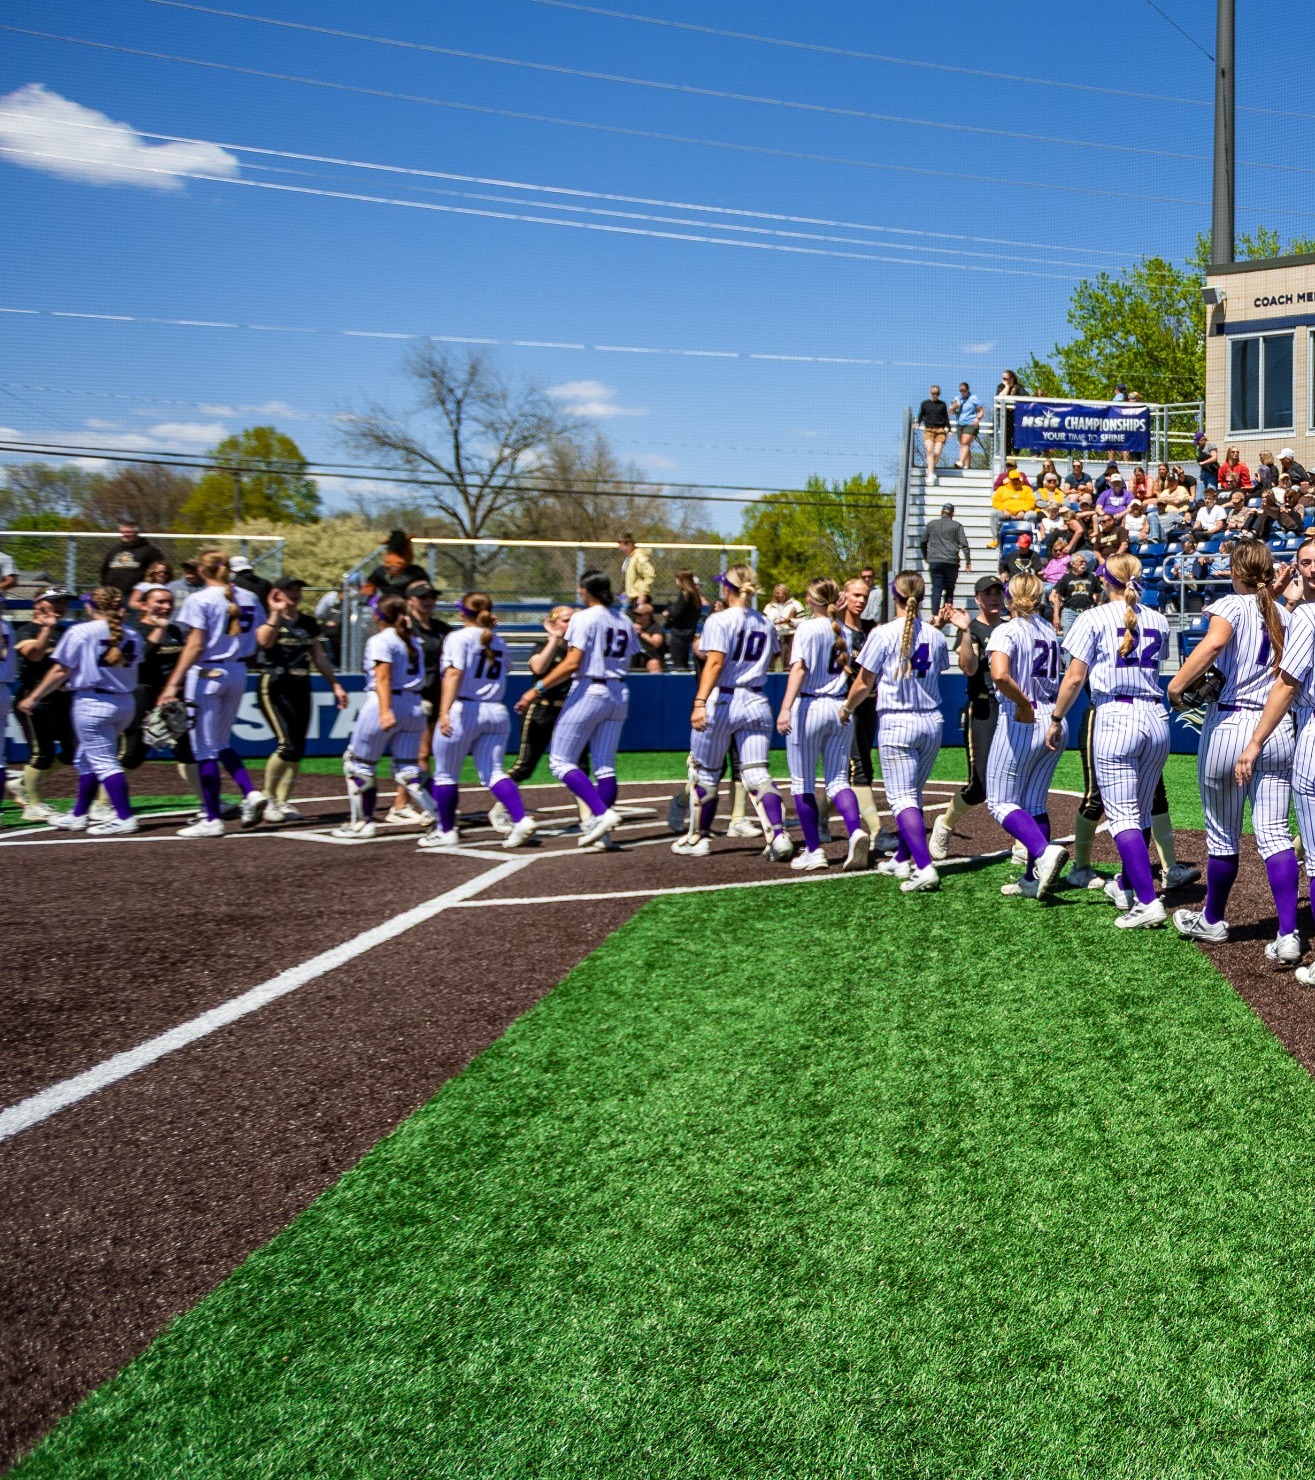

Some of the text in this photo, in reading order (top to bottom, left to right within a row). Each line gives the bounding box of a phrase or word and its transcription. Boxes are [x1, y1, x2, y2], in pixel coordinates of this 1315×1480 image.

[1254, 293, 1294, 308] COACH
[1042, 431, 1125, 443] YOUR TIME TO SHINE
[1064, 416, 1147, 432] CHAMPIONSHIPS
[604, 627, 629, 658] 13
[733, 630, 767, 662] 10
[1115, 627, 1160, 669] 22
[911, 643, 932, 678] 4
[1031, 639, 1058, 679] 21
